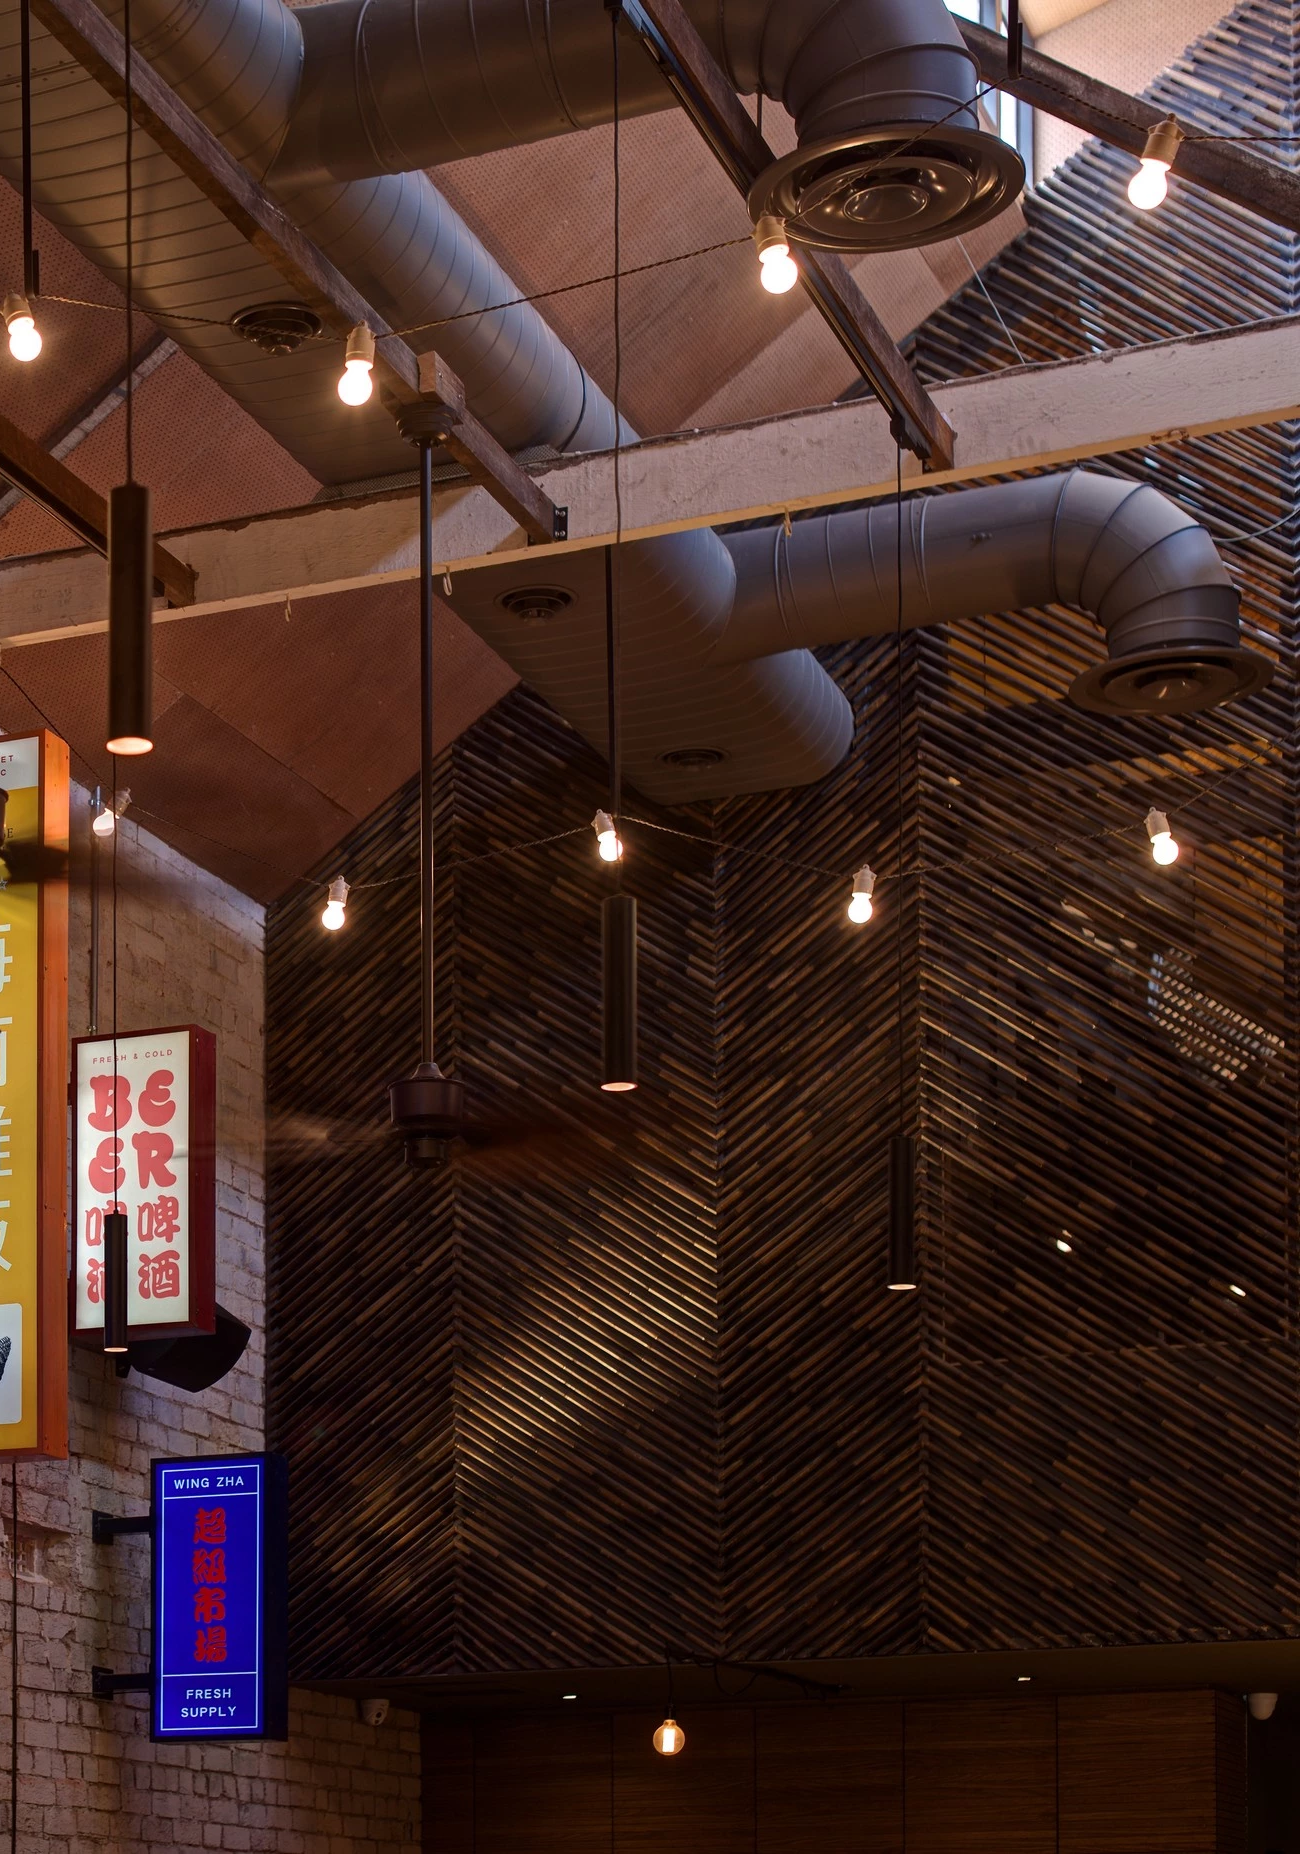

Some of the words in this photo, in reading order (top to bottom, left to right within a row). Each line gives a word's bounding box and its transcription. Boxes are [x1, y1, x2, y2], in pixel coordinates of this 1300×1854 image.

[92, 1054, 127, 1065] FRESH
[144, 1048, 173, 1059] COLD
[174, 1477, 210, 1489] WING
[216, 1476, 244, 1487] ZHA
[186, 1688, 232, 1700] FRESH
[181, 1706, 237, 1718] SUPPLY
